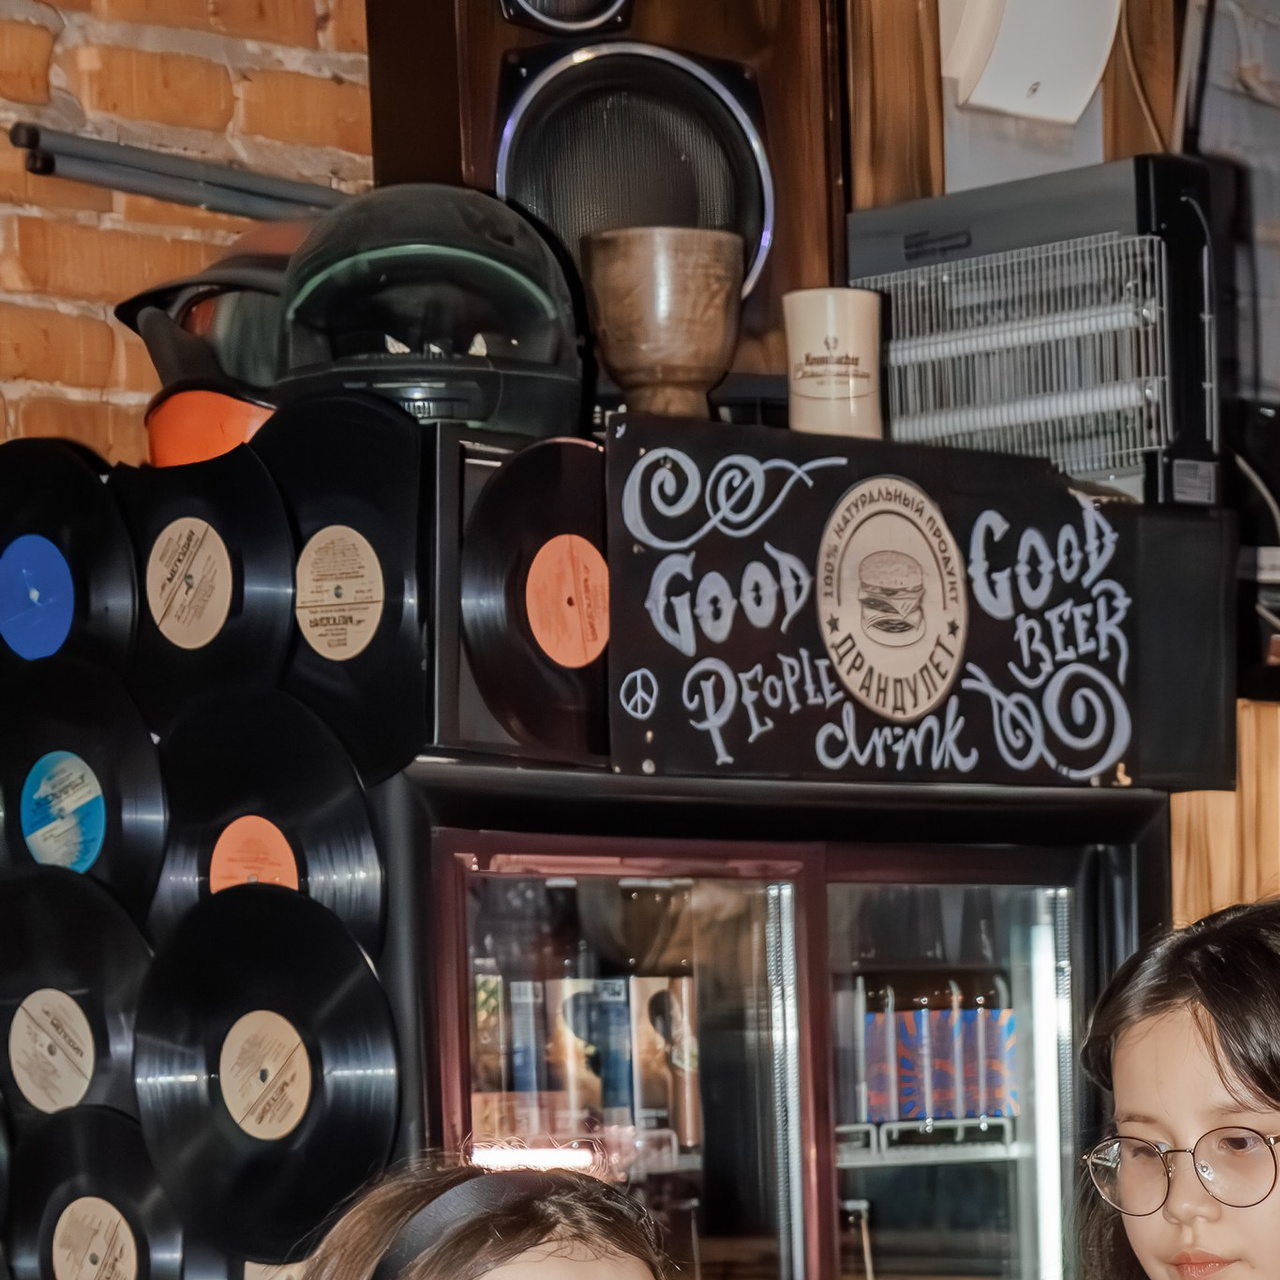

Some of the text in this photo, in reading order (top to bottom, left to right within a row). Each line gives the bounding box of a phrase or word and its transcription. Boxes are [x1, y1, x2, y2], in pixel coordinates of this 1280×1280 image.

[645, 541, 814, 657] GOOD
[822, 487, 960, 604] 100% НАТУРАЛЬНЫЙ ПРОДУКТ
[830, 633, 955, 716] ДРАНДУЛЕТ
[1008, 579, 1132, 690] BEER
[815, 697, 979, 773] drink
